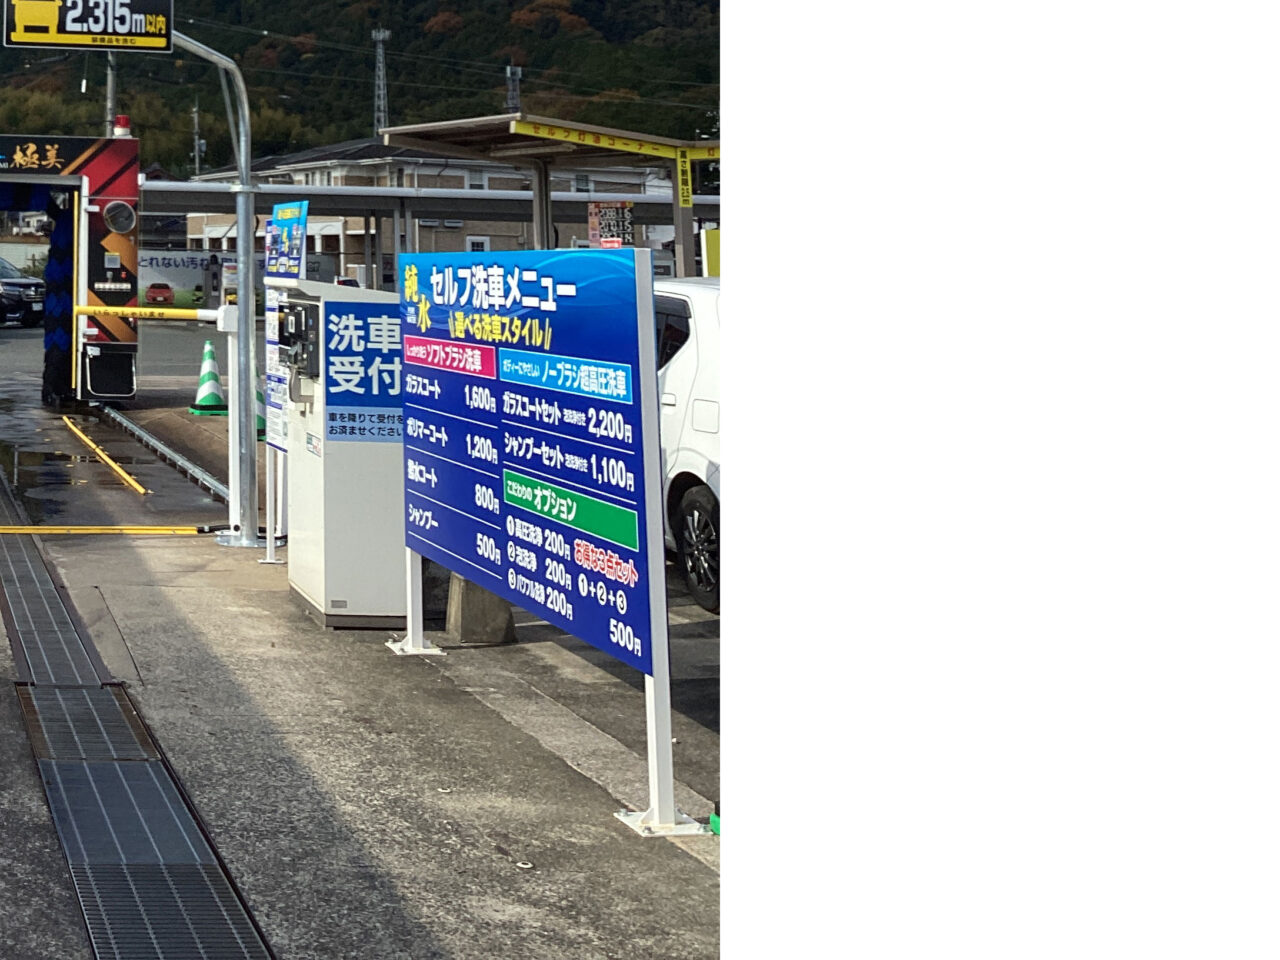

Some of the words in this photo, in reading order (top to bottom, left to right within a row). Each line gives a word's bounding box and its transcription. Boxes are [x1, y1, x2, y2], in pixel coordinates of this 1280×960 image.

[10, 142, 65, 169] 極美
[532, 123, 660, 151] セルフ灯油コーナー
[430, 264, 577, 311] セルフ洗車メニュー
[328, 313, 402, 353] 洗車
[328, 356, 402, 396] 受付
[405, 373, 441, 400] ガラスコート
[502, 391, 561, 426] ガラスコートセット
[587, 407, 633, 444] 2,200円
[406, 417, 448, 448] ポリマーコート
[466, 433, 499, 465] 1,200円
[504, 432, 564, 469] シャンプーセット
[590, 453, 635, 492] 1,100円
[474, 483, 500, 515] 800円
[533, 486, 577, 521] オプション
[408, 503, 439, 530] シャンプー
[476, 532, 501, 566] 500円
[544, 528, 571, 561] 200円
[545, 557, 572, 591] 200円
[574, 538, 639, 588] お得な3点セット
[546, 586, 573, 621] 200円
[609, 618, 642, 657] 500円
